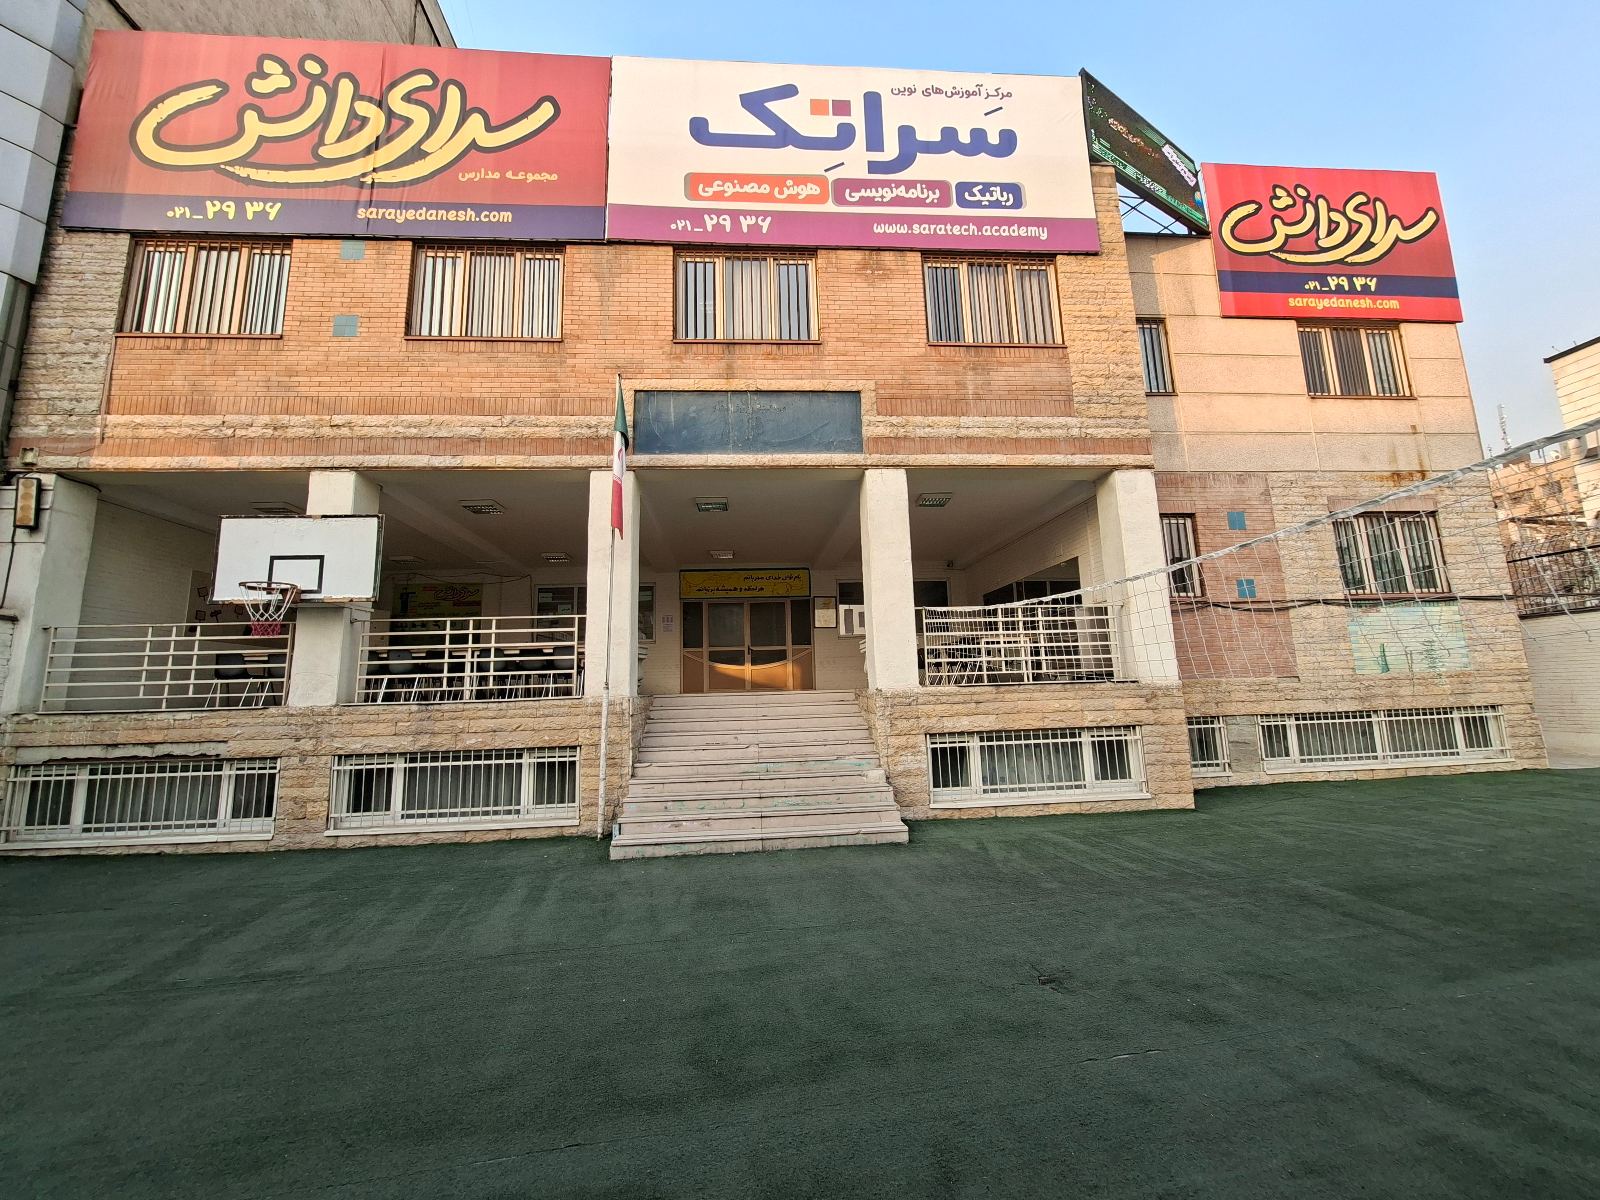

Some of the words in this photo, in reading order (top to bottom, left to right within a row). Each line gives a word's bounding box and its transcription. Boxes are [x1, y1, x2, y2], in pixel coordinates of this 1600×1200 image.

[890, 84, 917, 97] نوین
[984, 86, 1013, 100] مرکز
[130, 54, 388, 169] دانش
[457, 168, 500, 182] مدارس
[505, 170, 559, 183] مجموعه
[697, 180, 771, 198] مصنوعی
[773, 179, 822, 200] هوش
[963, 185, 1015, 207] رباتیک
[357, 206, 513, 224] sarayedanesh.com
[1219, 184, 1350, 256] دانش
[872, 221, 1048, 240] www.saratech.academy
[1288, 296, 1400, 310] sarayedanesh.com
